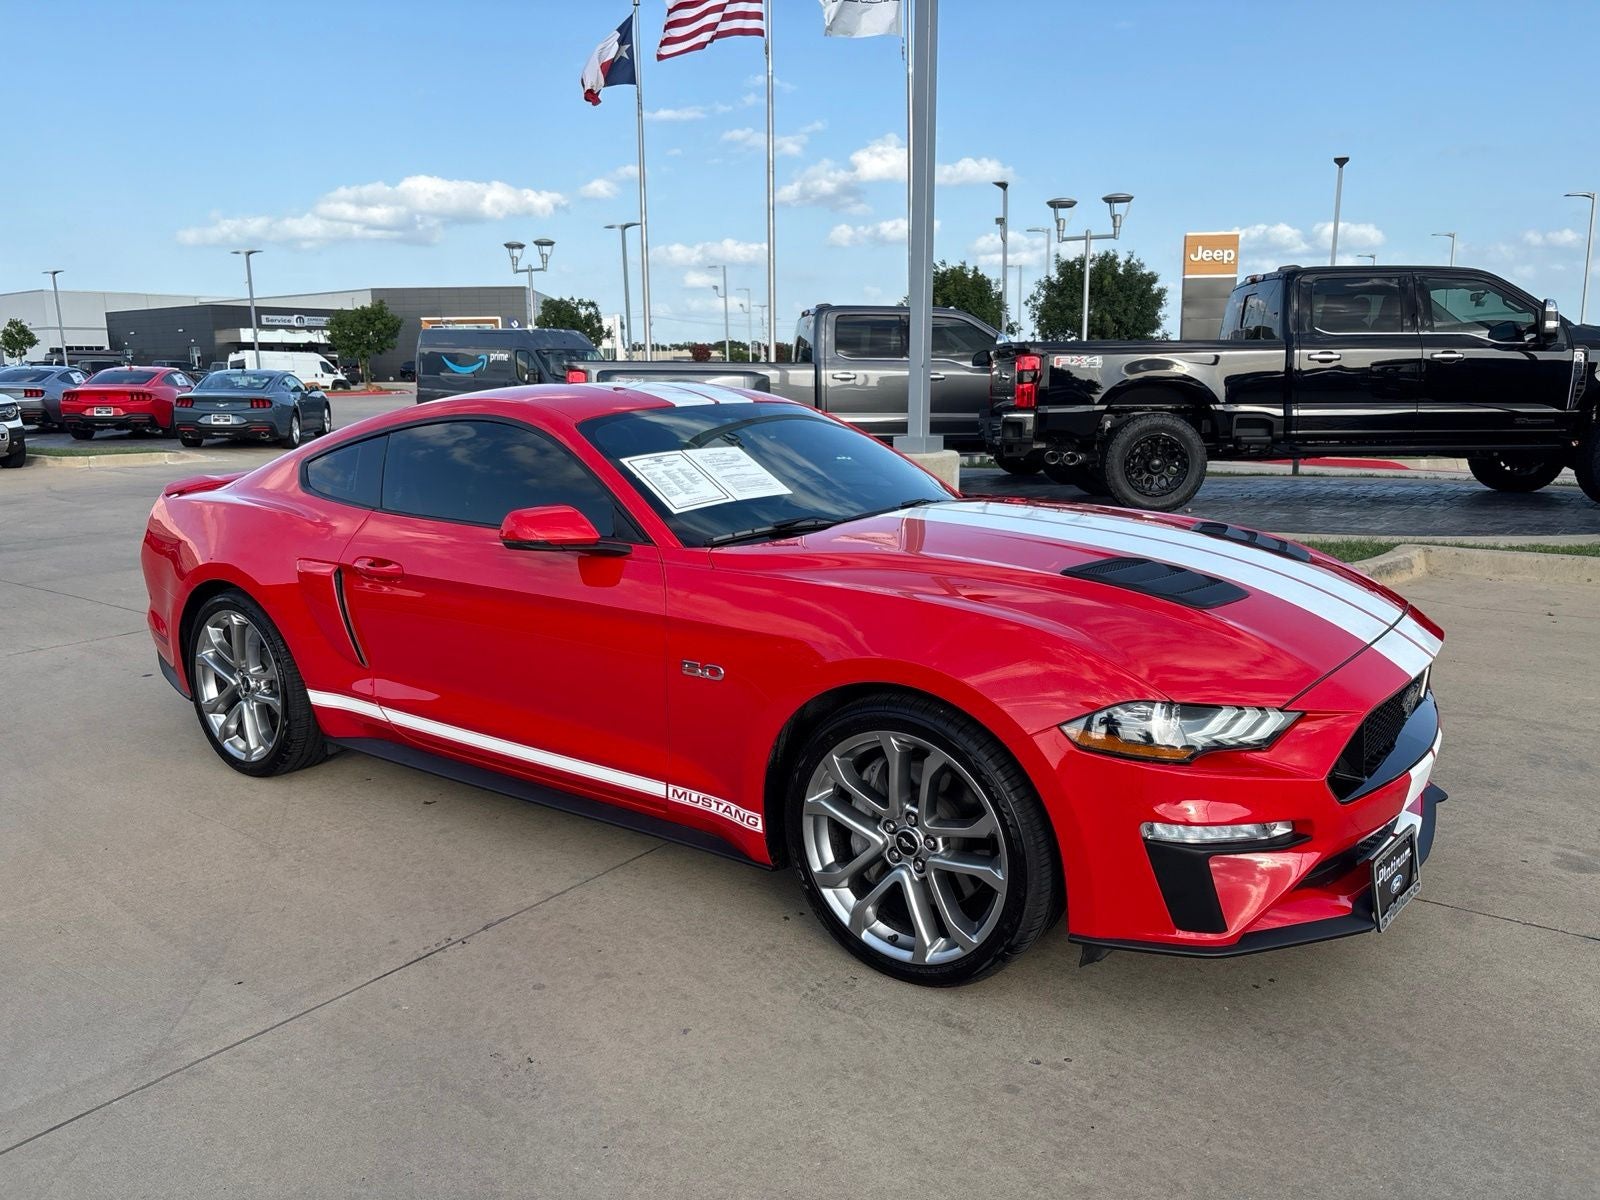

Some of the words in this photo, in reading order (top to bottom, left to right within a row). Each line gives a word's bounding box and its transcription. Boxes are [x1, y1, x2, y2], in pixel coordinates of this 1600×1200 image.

[1190, 246, 1235, 264] Jeep
[490, 350, 509, 363] prime
[1054, 355, 1103, 369] FX4
[682, 659, 725, 681] 5.0
[672, 788, 760, 828] MUSTANG
